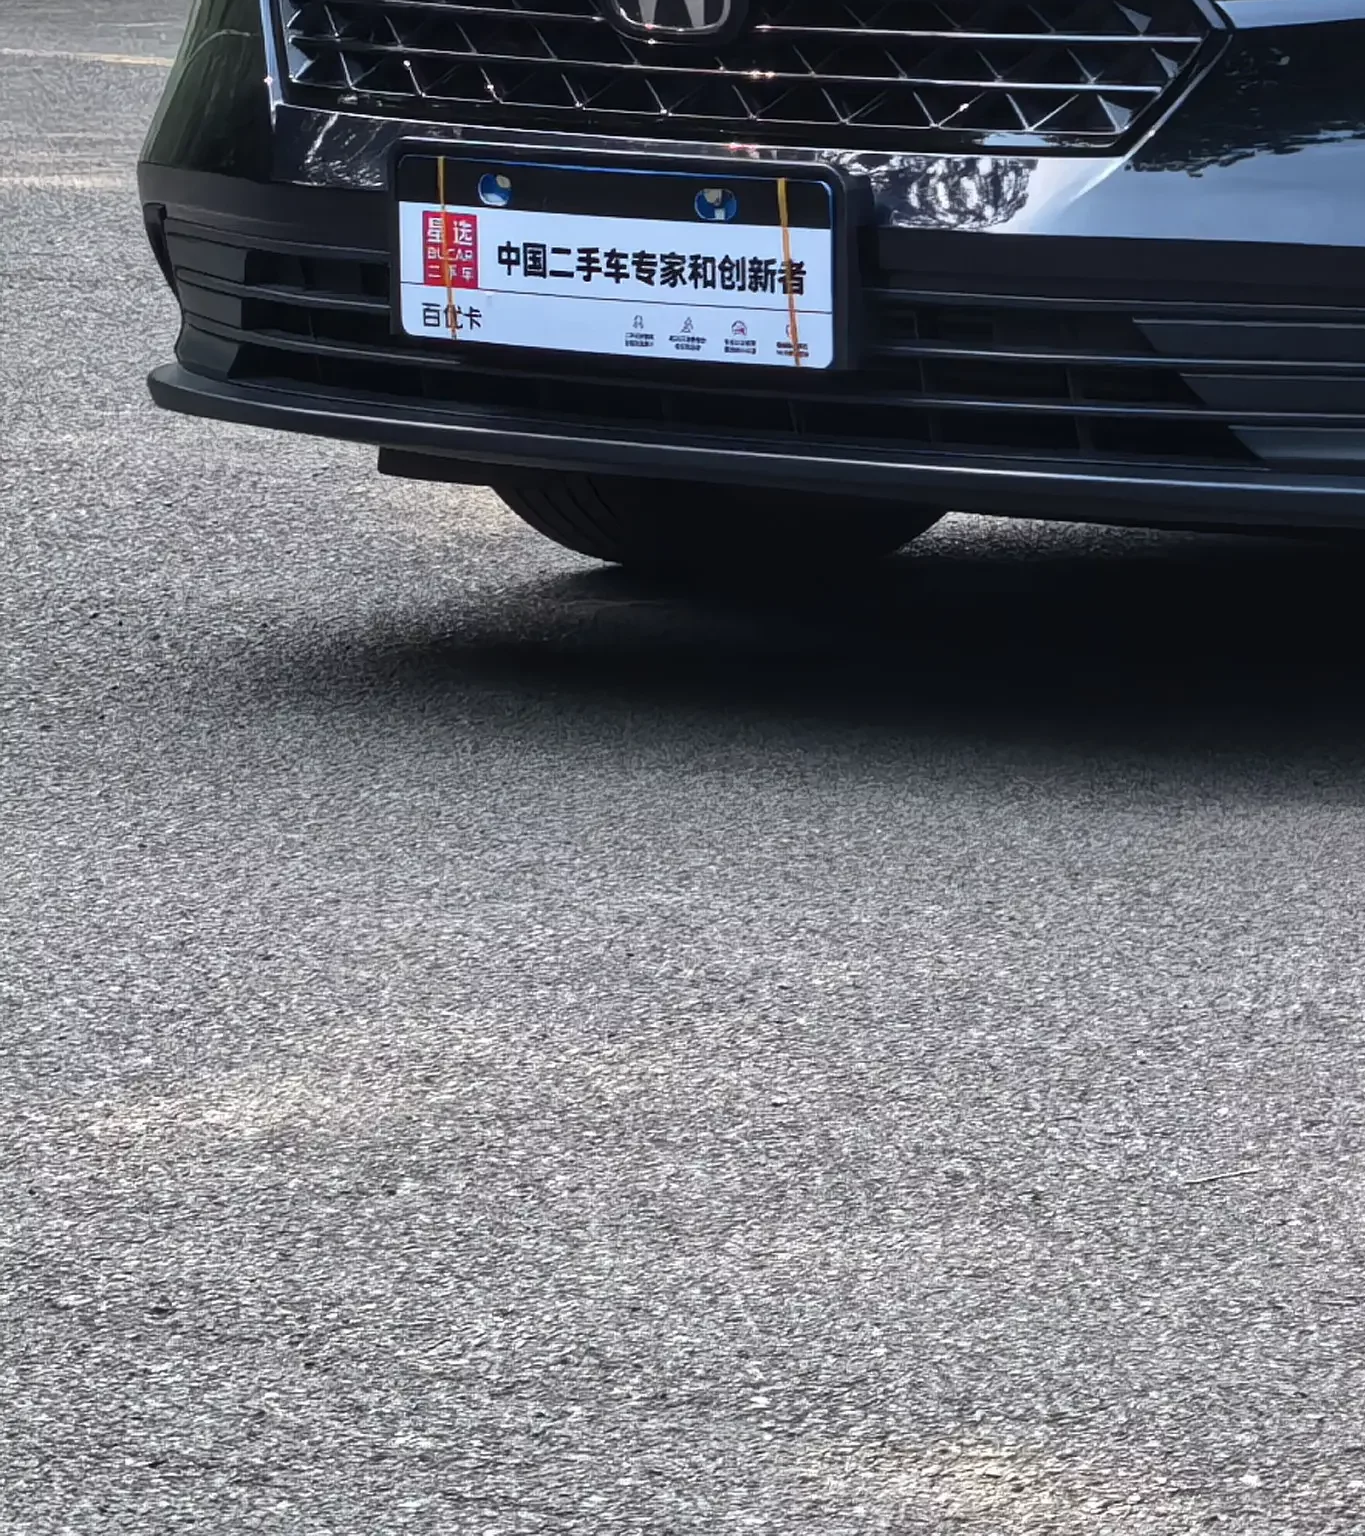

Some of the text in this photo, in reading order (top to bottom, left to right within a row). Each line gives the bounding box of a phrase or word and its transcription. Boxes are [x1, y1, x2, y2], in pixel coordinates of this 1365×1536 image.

[427, 217, 473, 246] 星选
[427, 264, 474, 283] 二手车
[498, 240, 807, 296] 中国二手车专家和创新者
